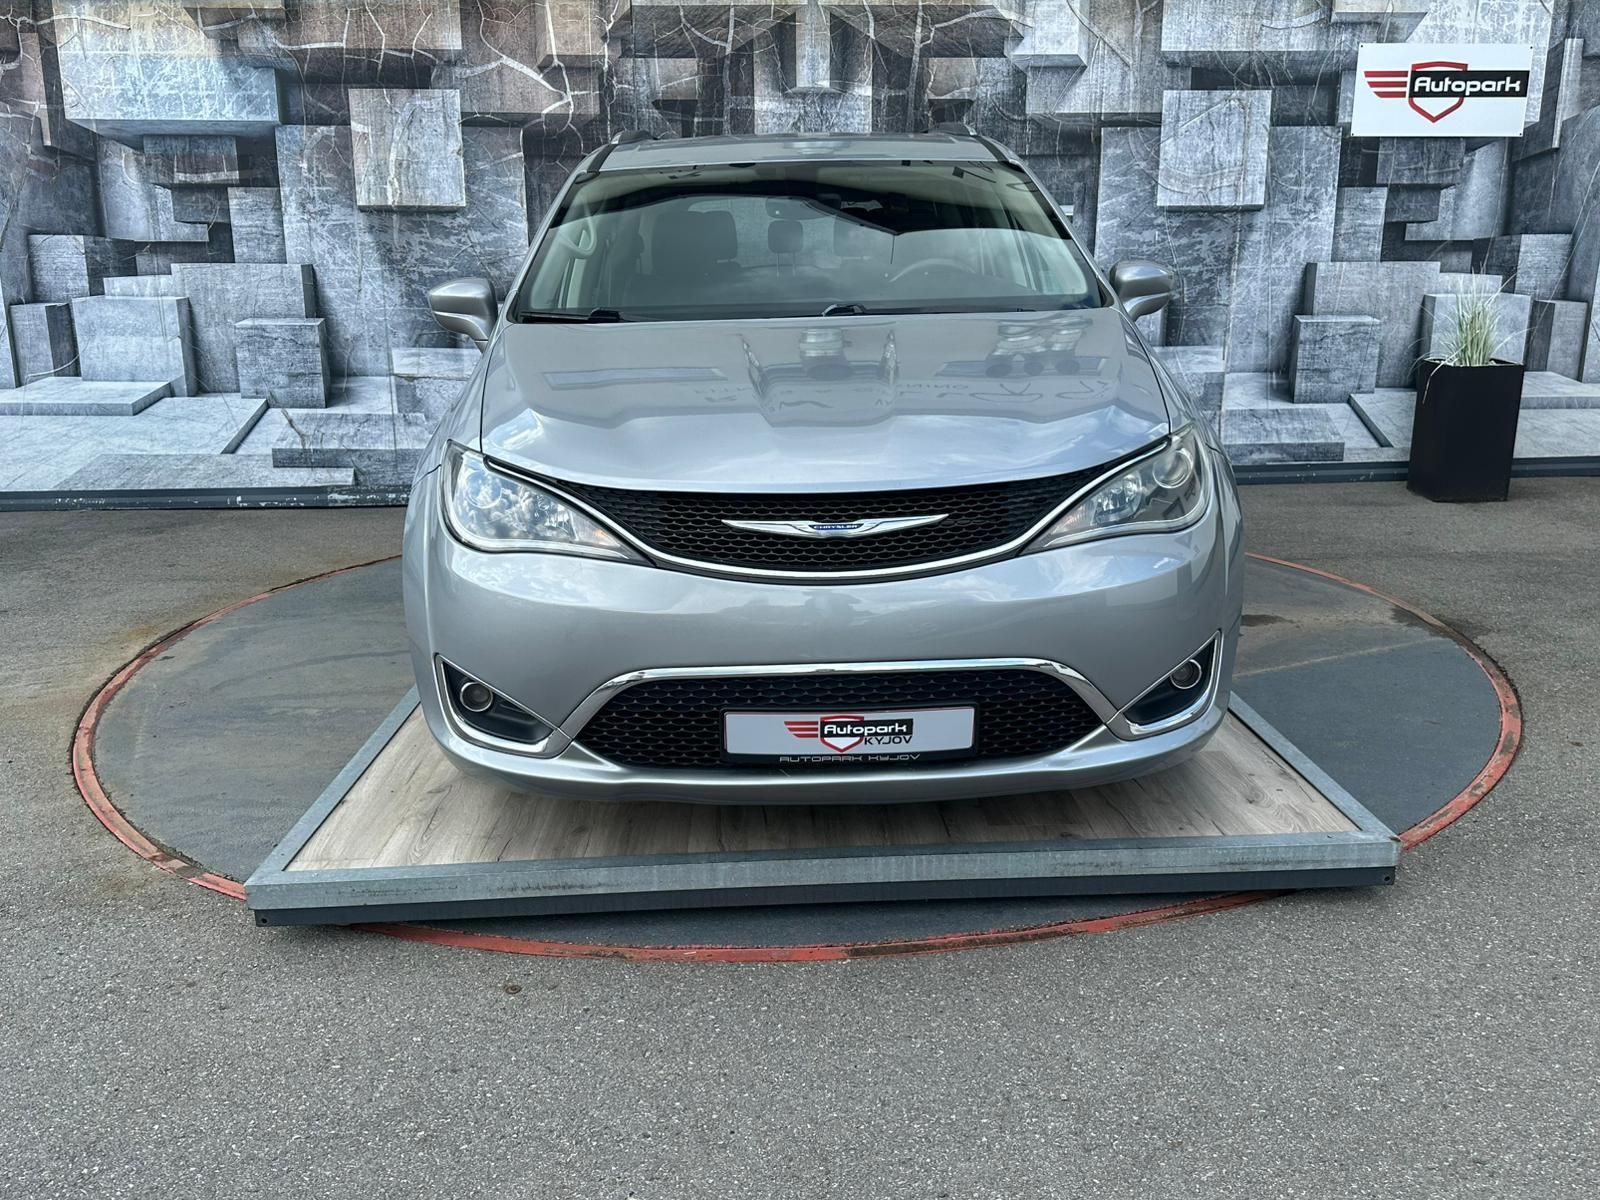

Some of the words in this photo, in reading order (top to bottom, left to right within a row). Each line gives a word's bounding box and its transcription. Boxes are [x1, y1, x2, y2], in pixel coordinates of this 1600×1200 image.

[1414, 76, 1521, 96] Autopark
[824, 722, 907, 736] Autopark
[864, 735, 912, 745] KYJOV
[779, 755, 862, 763] AUTOPARK
[868, 753, 921, 761] KYJOV
